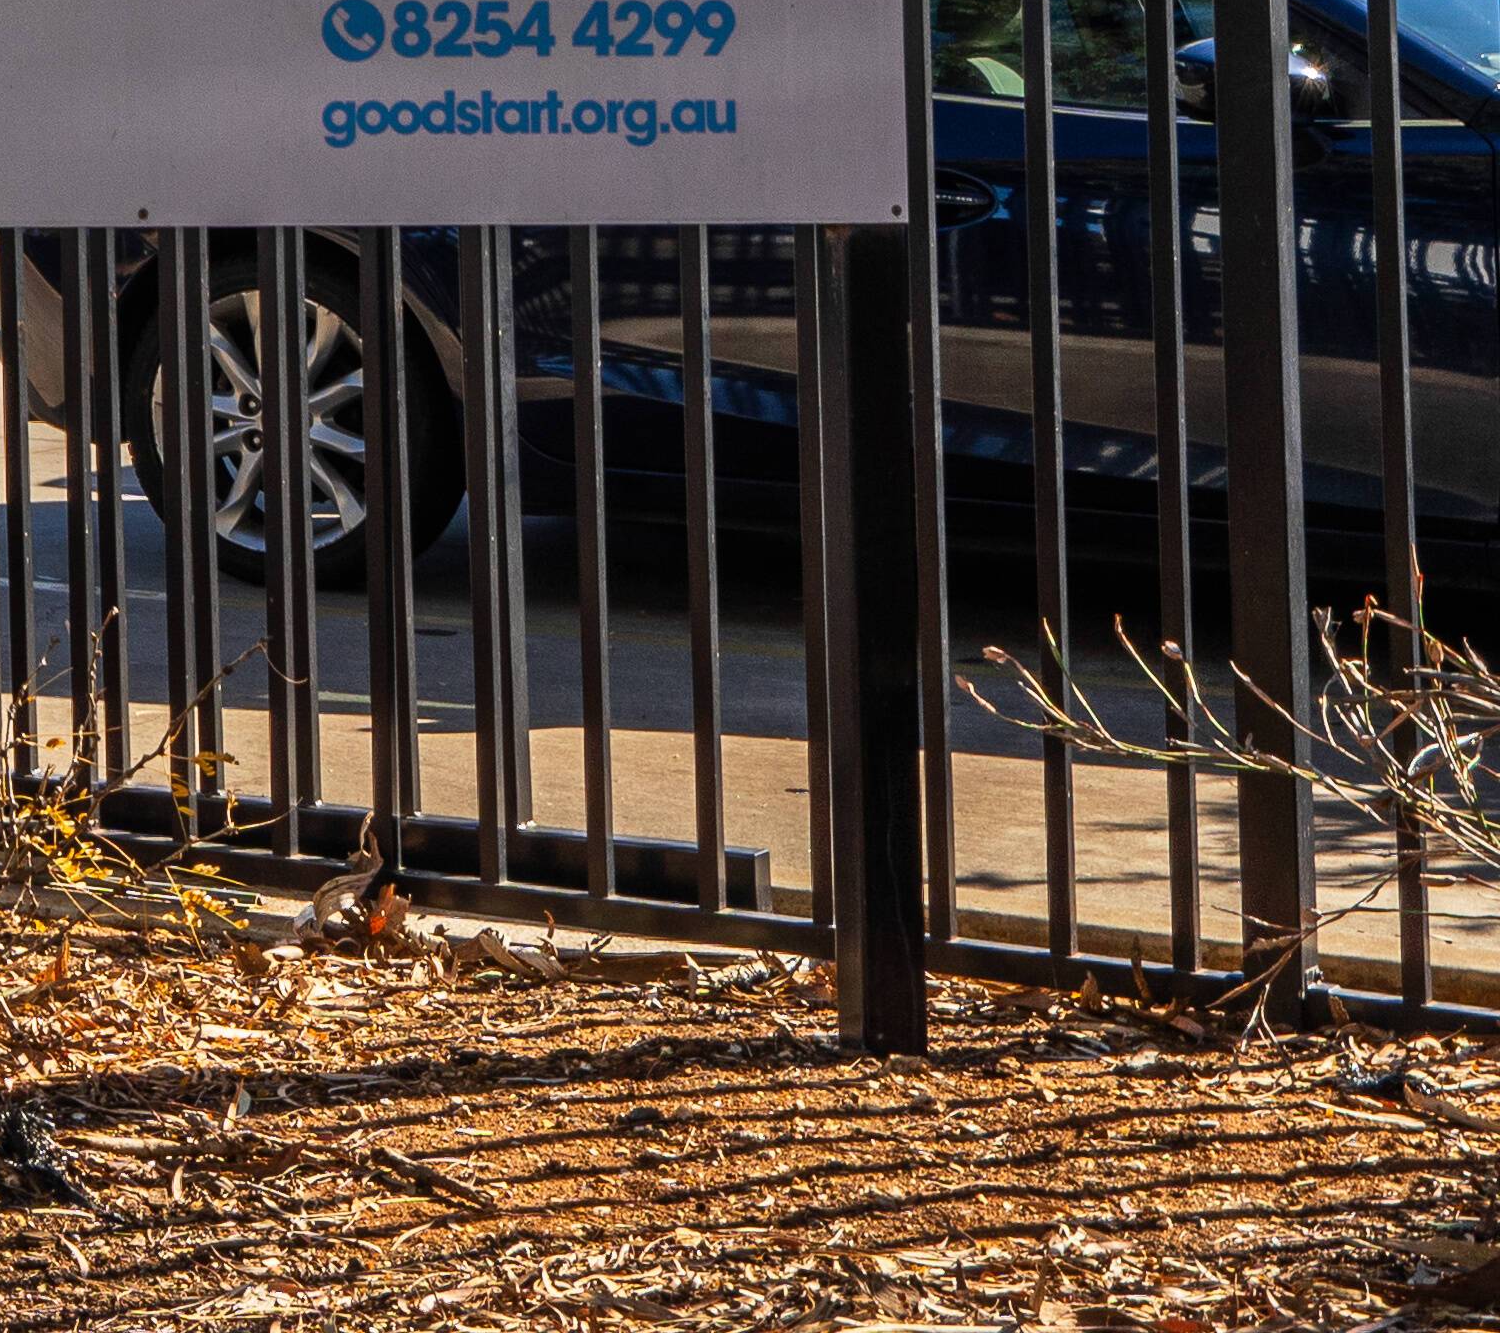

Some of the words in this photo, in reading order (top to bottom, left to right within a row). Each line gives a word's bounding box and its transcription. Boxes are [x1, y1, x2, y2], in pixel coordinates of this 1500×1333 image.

[390, 0, 556, 59] 8254
[571, 0, 737, 58] 4299
[321, 89, 737, 149] goodstart.org.au
